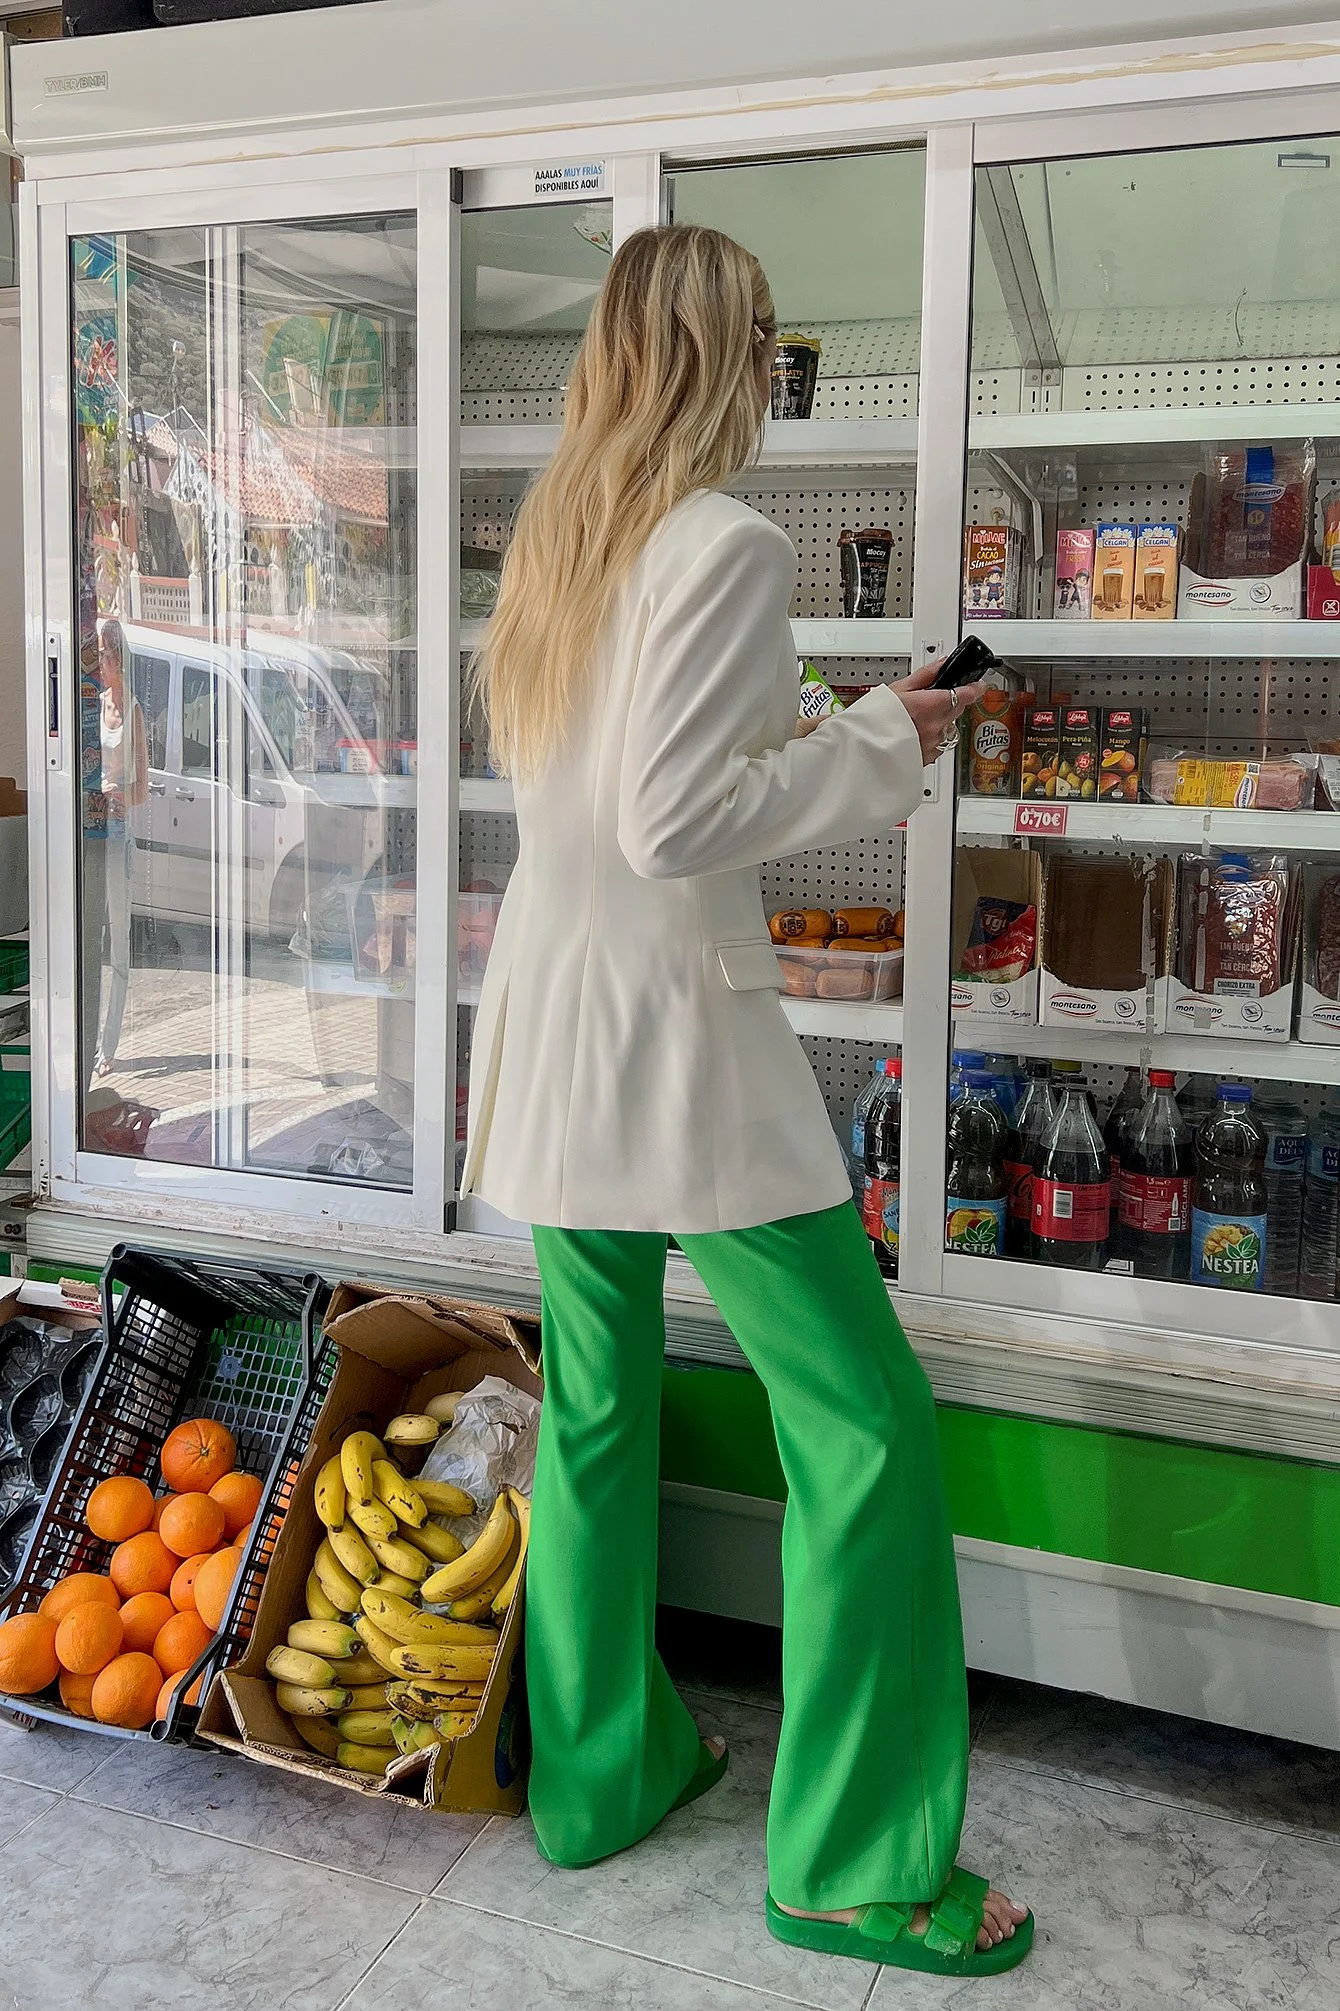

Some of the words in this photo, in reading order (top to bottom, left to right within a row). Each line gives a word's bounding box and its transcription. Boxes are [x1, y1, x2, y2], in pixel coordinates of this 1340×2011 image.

[535, 169, 562, 180] AAALAS
[564, 168, 580, 177] MUY
[583, 164, 603, 176] FRÍAS
[535, 180, 579, 193] DISPONIBLES
[581, 176, 599, 189] AQUÍ
[1236, 487, 1282, 499] montesano
[866, 548, 886, 558] Mocay
[976, 551, 999, 560] CACAO
[970, 559, 985, 570] Sin
[1185, 591, 1232, 600] montesano
[800, 687, 814, 706] Bi
[803, 689, 830, 719] frutas
[982, 724, 994, 738] Bi
[976, 735, 1009, 750] frutas
[1109, 737, 1130, 745] Mango
[976, 762, 1006, 772] Original
[1220, 941, 1231, 951] TAN
[1220, 961, 1231, 971] TAN
[1217, 981, 1239, 989] CHORIZO
[1239, 981, 1255, 990] EXTRA
[1050, 1000, 1097, 1011] montesano
[1202, 1254, 1259, 1275] NESTEA
